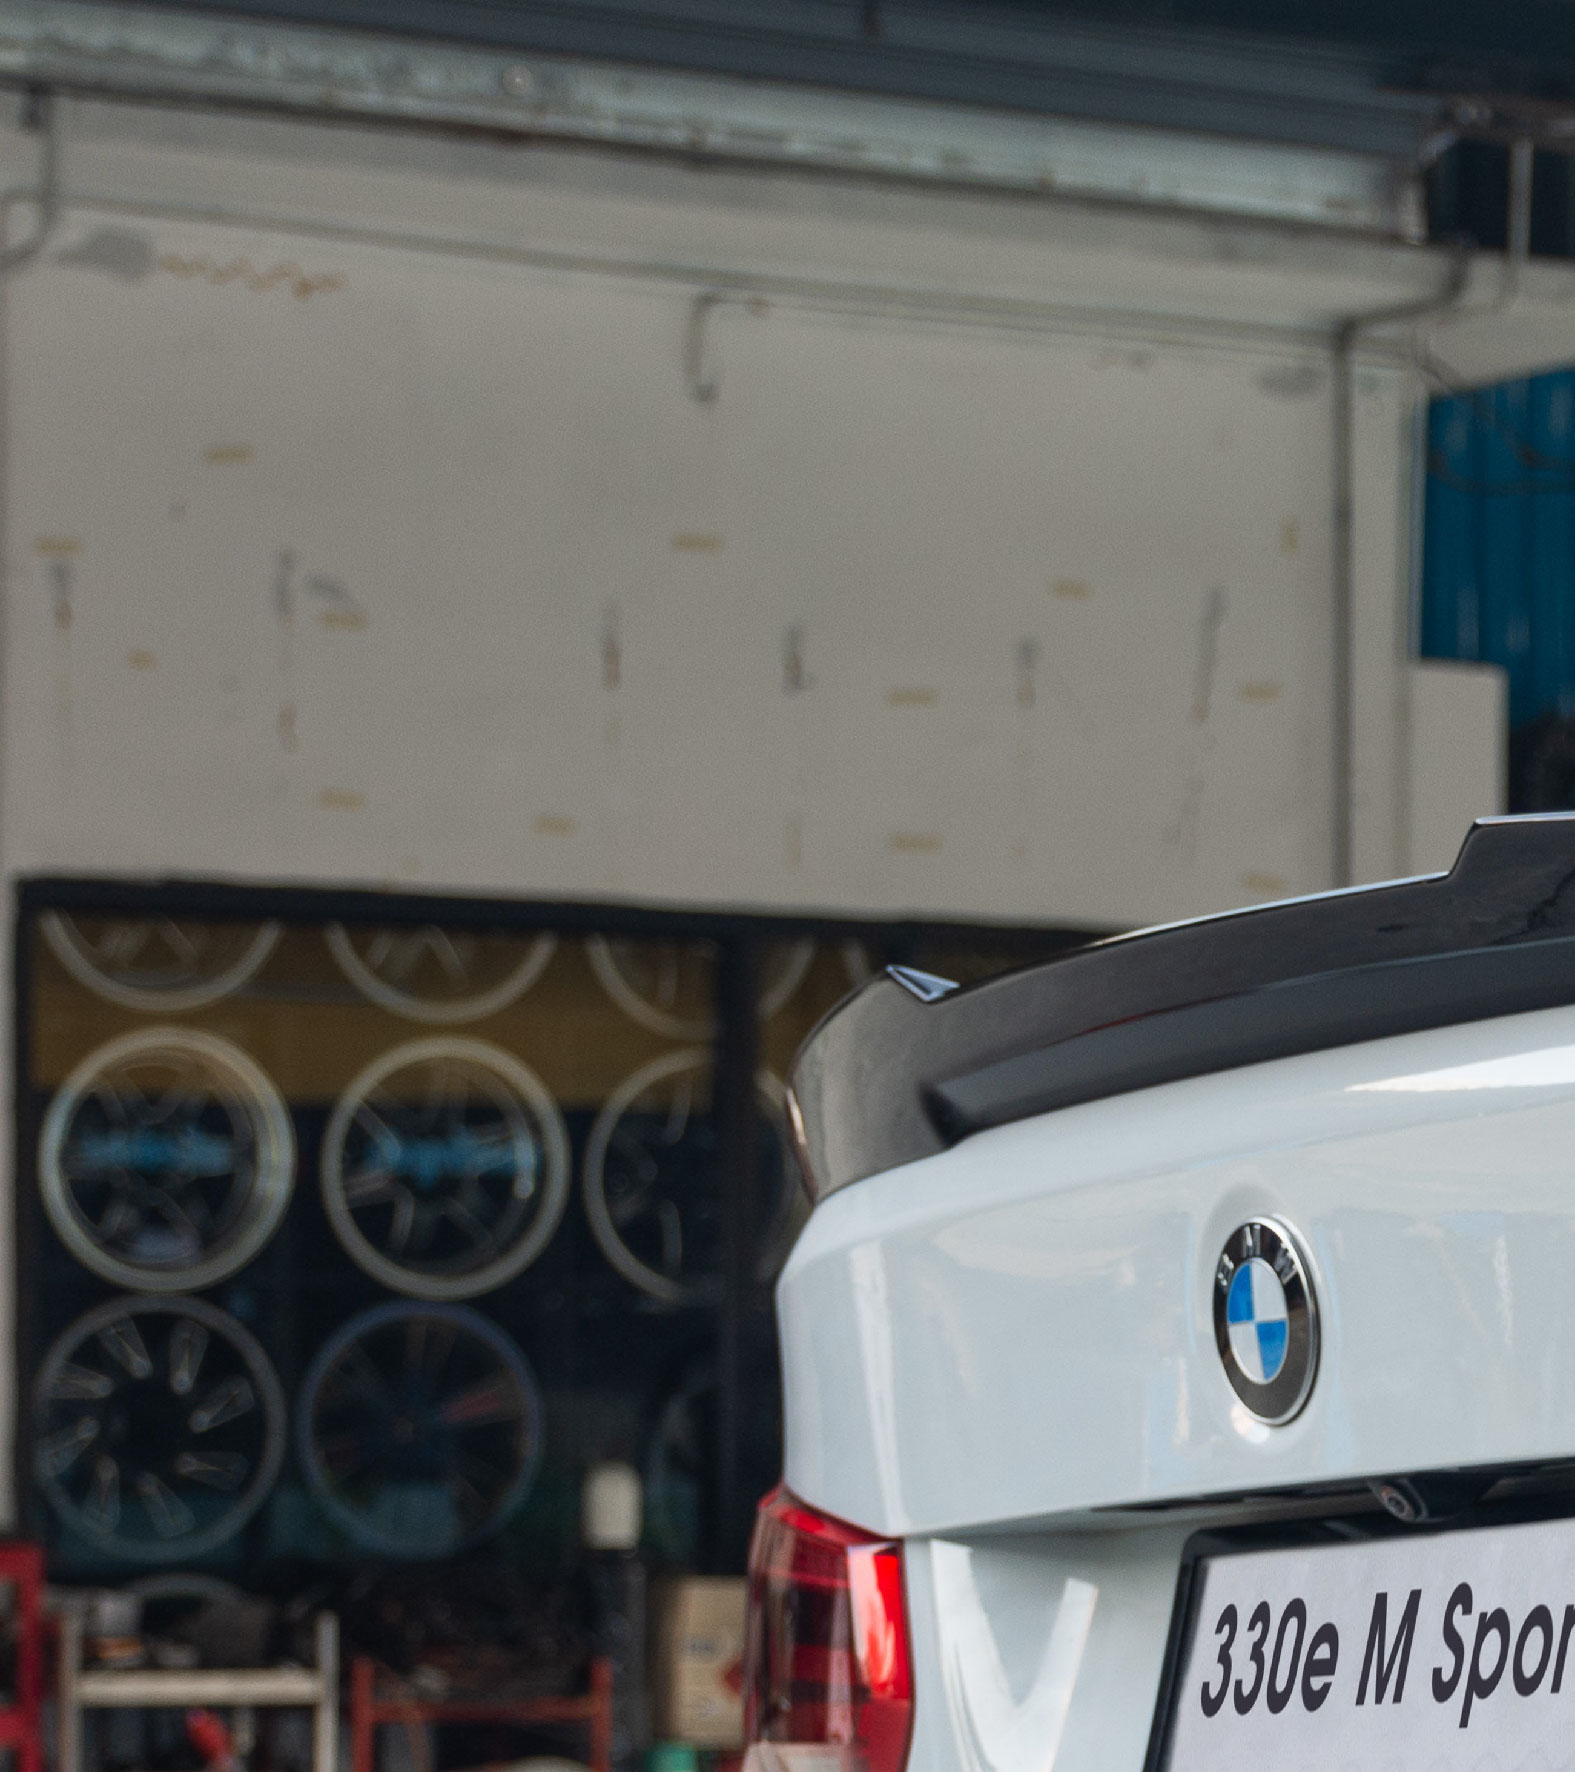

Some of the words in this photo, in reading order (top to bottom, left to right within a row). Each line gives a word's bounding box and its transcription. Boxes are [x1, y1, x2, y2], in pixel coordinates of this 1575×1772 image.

[1218, 1223, 1299, 1286] BMW
[1201, 1597, 1339, 1718] 330e
[1355, 1589, 1422, 1706] M
